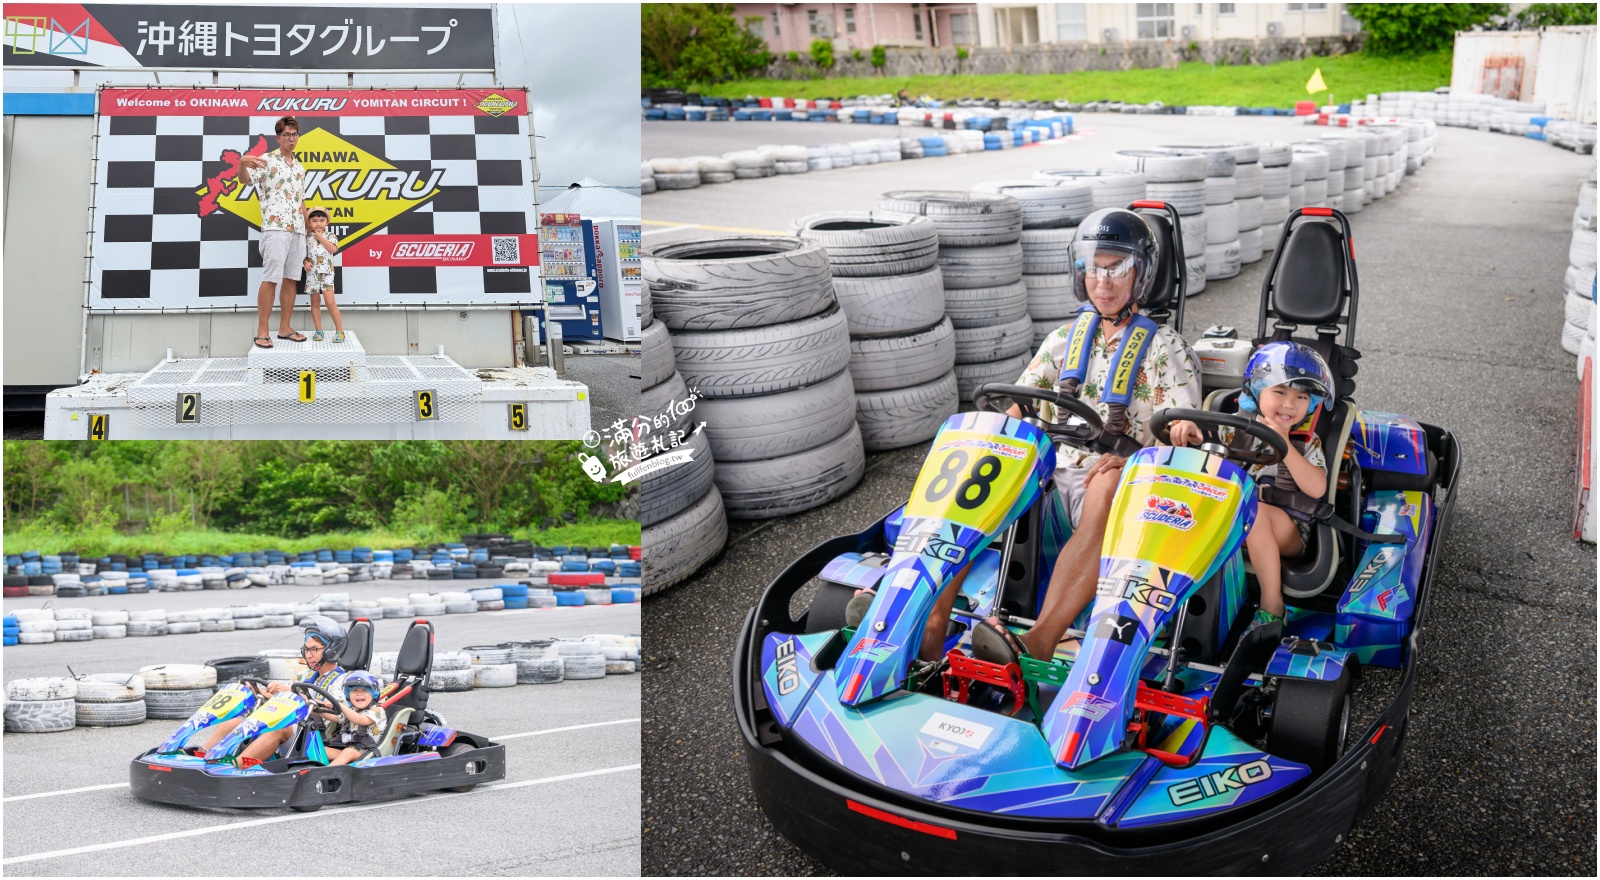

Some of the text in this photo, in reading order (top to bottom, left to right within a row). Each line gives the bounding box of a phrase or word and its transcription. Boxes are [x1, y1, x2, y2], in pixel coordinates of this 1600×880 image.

[135, 18, 458, 57] 沖縄トヨタグループ
[116, 98, 171, 107] Welcome
[174, 99, 187, 107] to
[190, 98, 249, 107] OKINAWA
[255, 96, 349, 112] KUKURU
[353, 98, 408, 108] YOMITAN
[409, 98, 460, 107] CIRCUIT
[292, 151, 360, 163] KINAWA
[369, 242, 471, 259] by SCUDERIA
[1068, 313, 1092, 366] Sabelt
[1116, 331, 1145, 389] Sabelt
[302, 373, 312, 399] 1
[182, 394, 196, 420] 2
[419, 392, 432, 417] 3
[512, 404, 524, 428] 5
[92, 416, 104, 440] 4
[924, 449, 1002, 510] 88
[1141, 511, 1192, 528] SCUDERIA
[894, 533, 966, 565] EIKO
[1348, 551, 1393, 593] EIKO
[1096, 576, 1177, 613] EIKO
[775, 638, 800, 696] EIKO
[1167, 759, 1273, 807] EIKO
